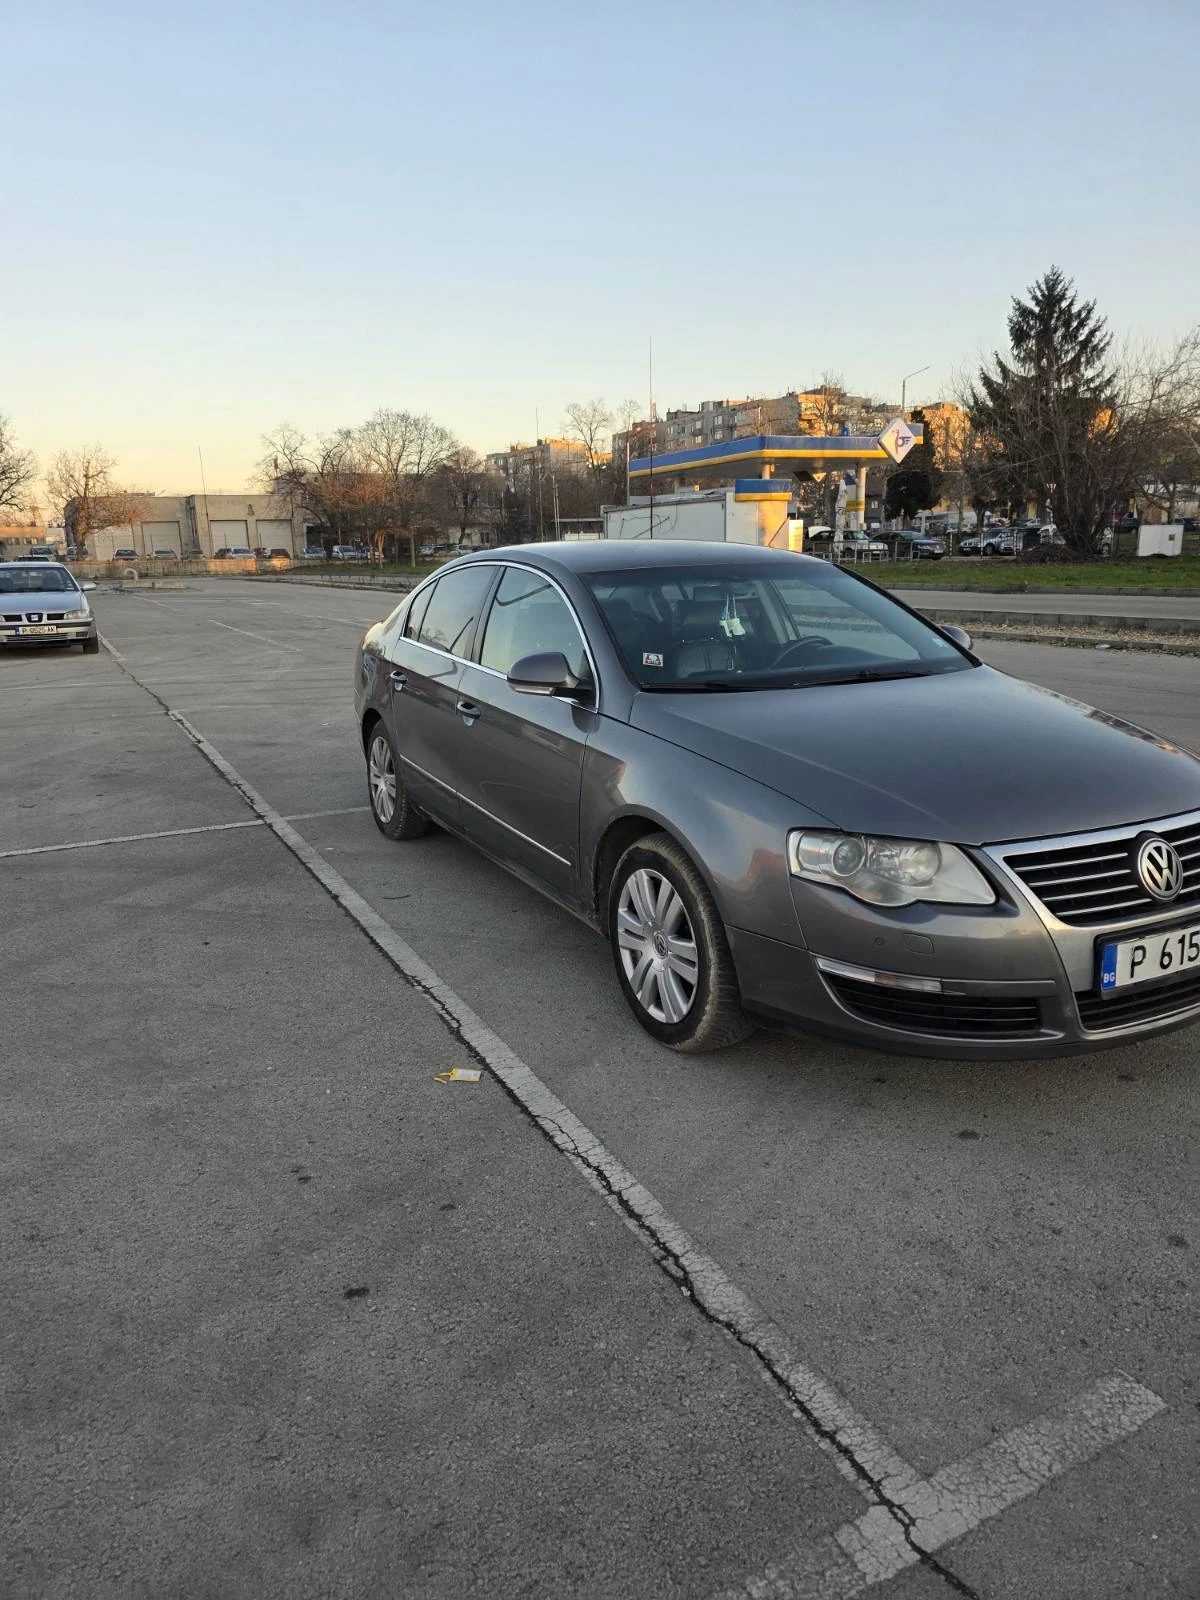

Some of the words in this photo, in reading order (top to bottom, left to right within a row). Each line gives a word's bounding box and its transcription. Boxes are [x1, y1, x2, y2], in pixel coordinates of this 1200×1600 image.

[1139, 841, 1182, 897] VW
[1103, 972, 1115, 983] BG
[1130, 945, 1147, 978] P
